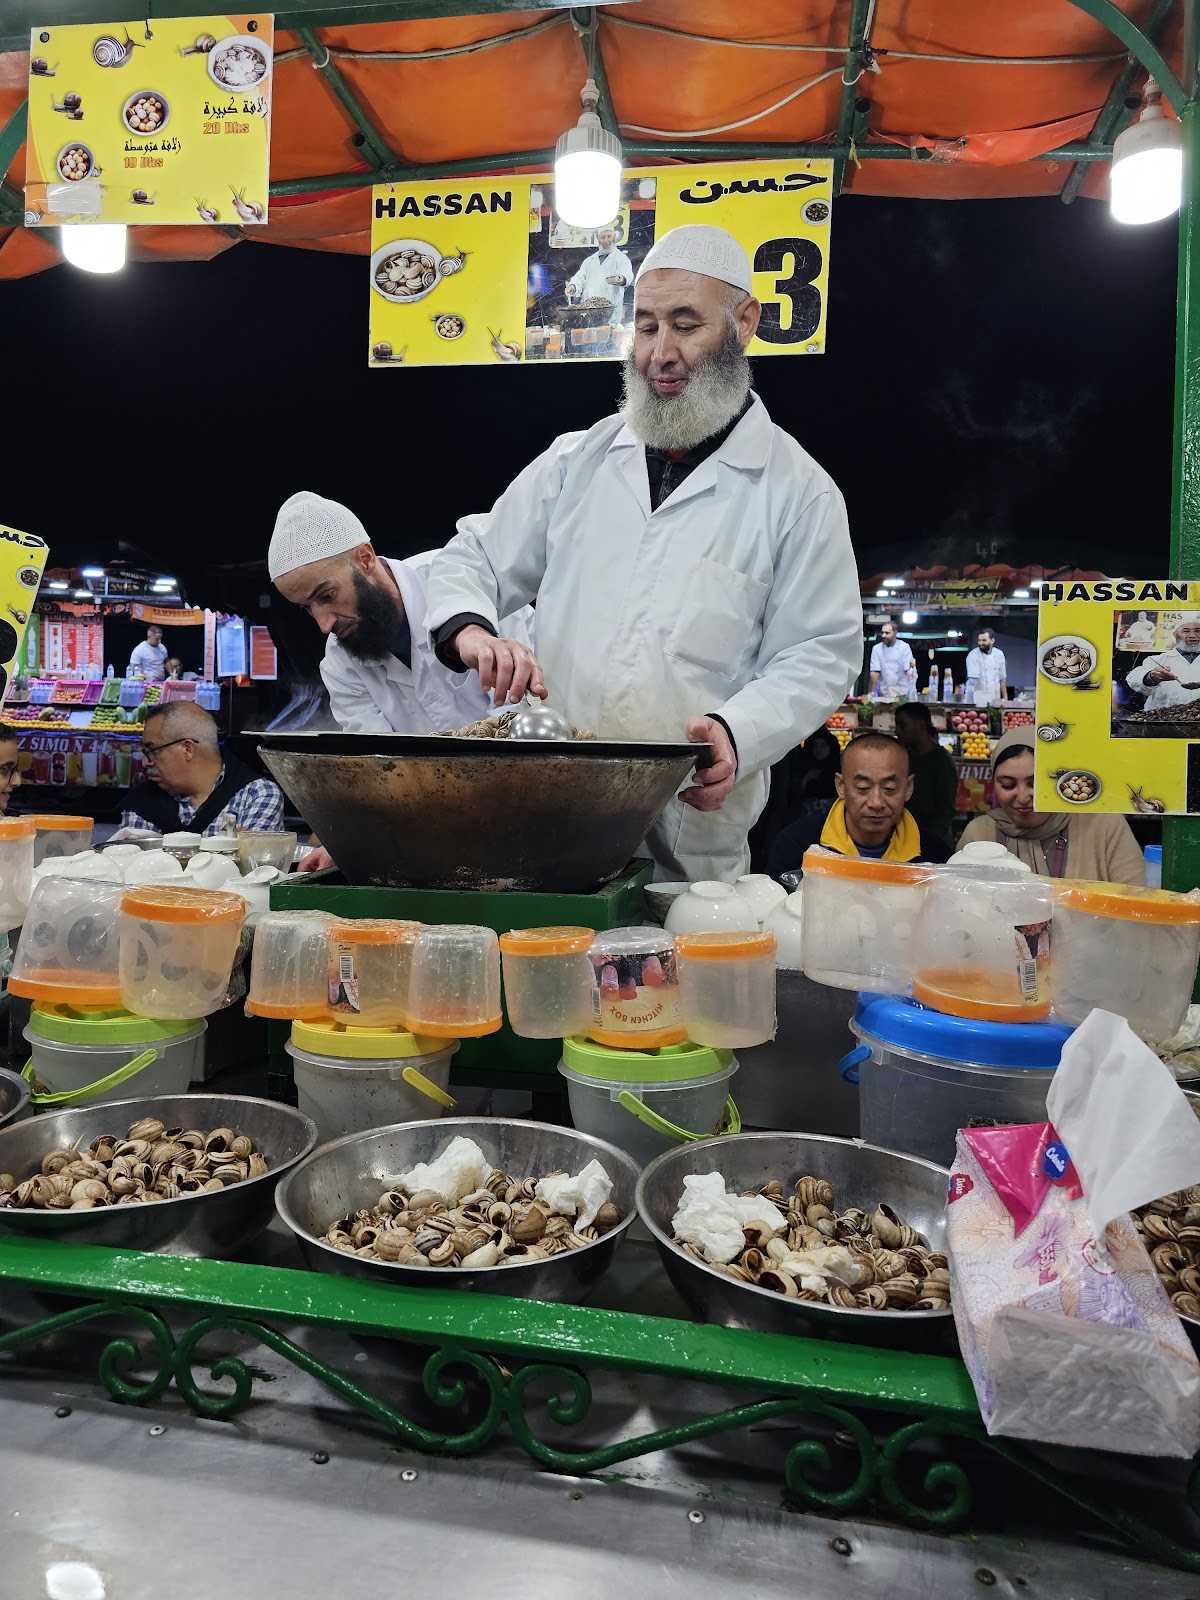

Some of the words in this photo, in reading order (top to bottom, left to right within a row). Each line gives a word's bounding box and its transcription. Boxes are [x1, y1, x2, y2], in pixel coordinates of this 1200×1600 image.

[203, 96, 239, 120] كبيرة
[203, 121, 221, 135] 20
[224, 121, 250, 135] Dhs
[123, 156, 138, 169] 10
[140, 156, 164, 168] Dhs
[679, 172, 828, 204] حسن
[375, 190, 512, 219] HASSAN
[753, 237, 823, 345] 3
[1041, 582, 1189, 601] HASSAN
[30, 737, 70, 752] SIMO
[89, 739, 109, 753] 44
[609, 1005, 628, 1022] BOX
[630, 1003, 664, 1024] KITCHEN
